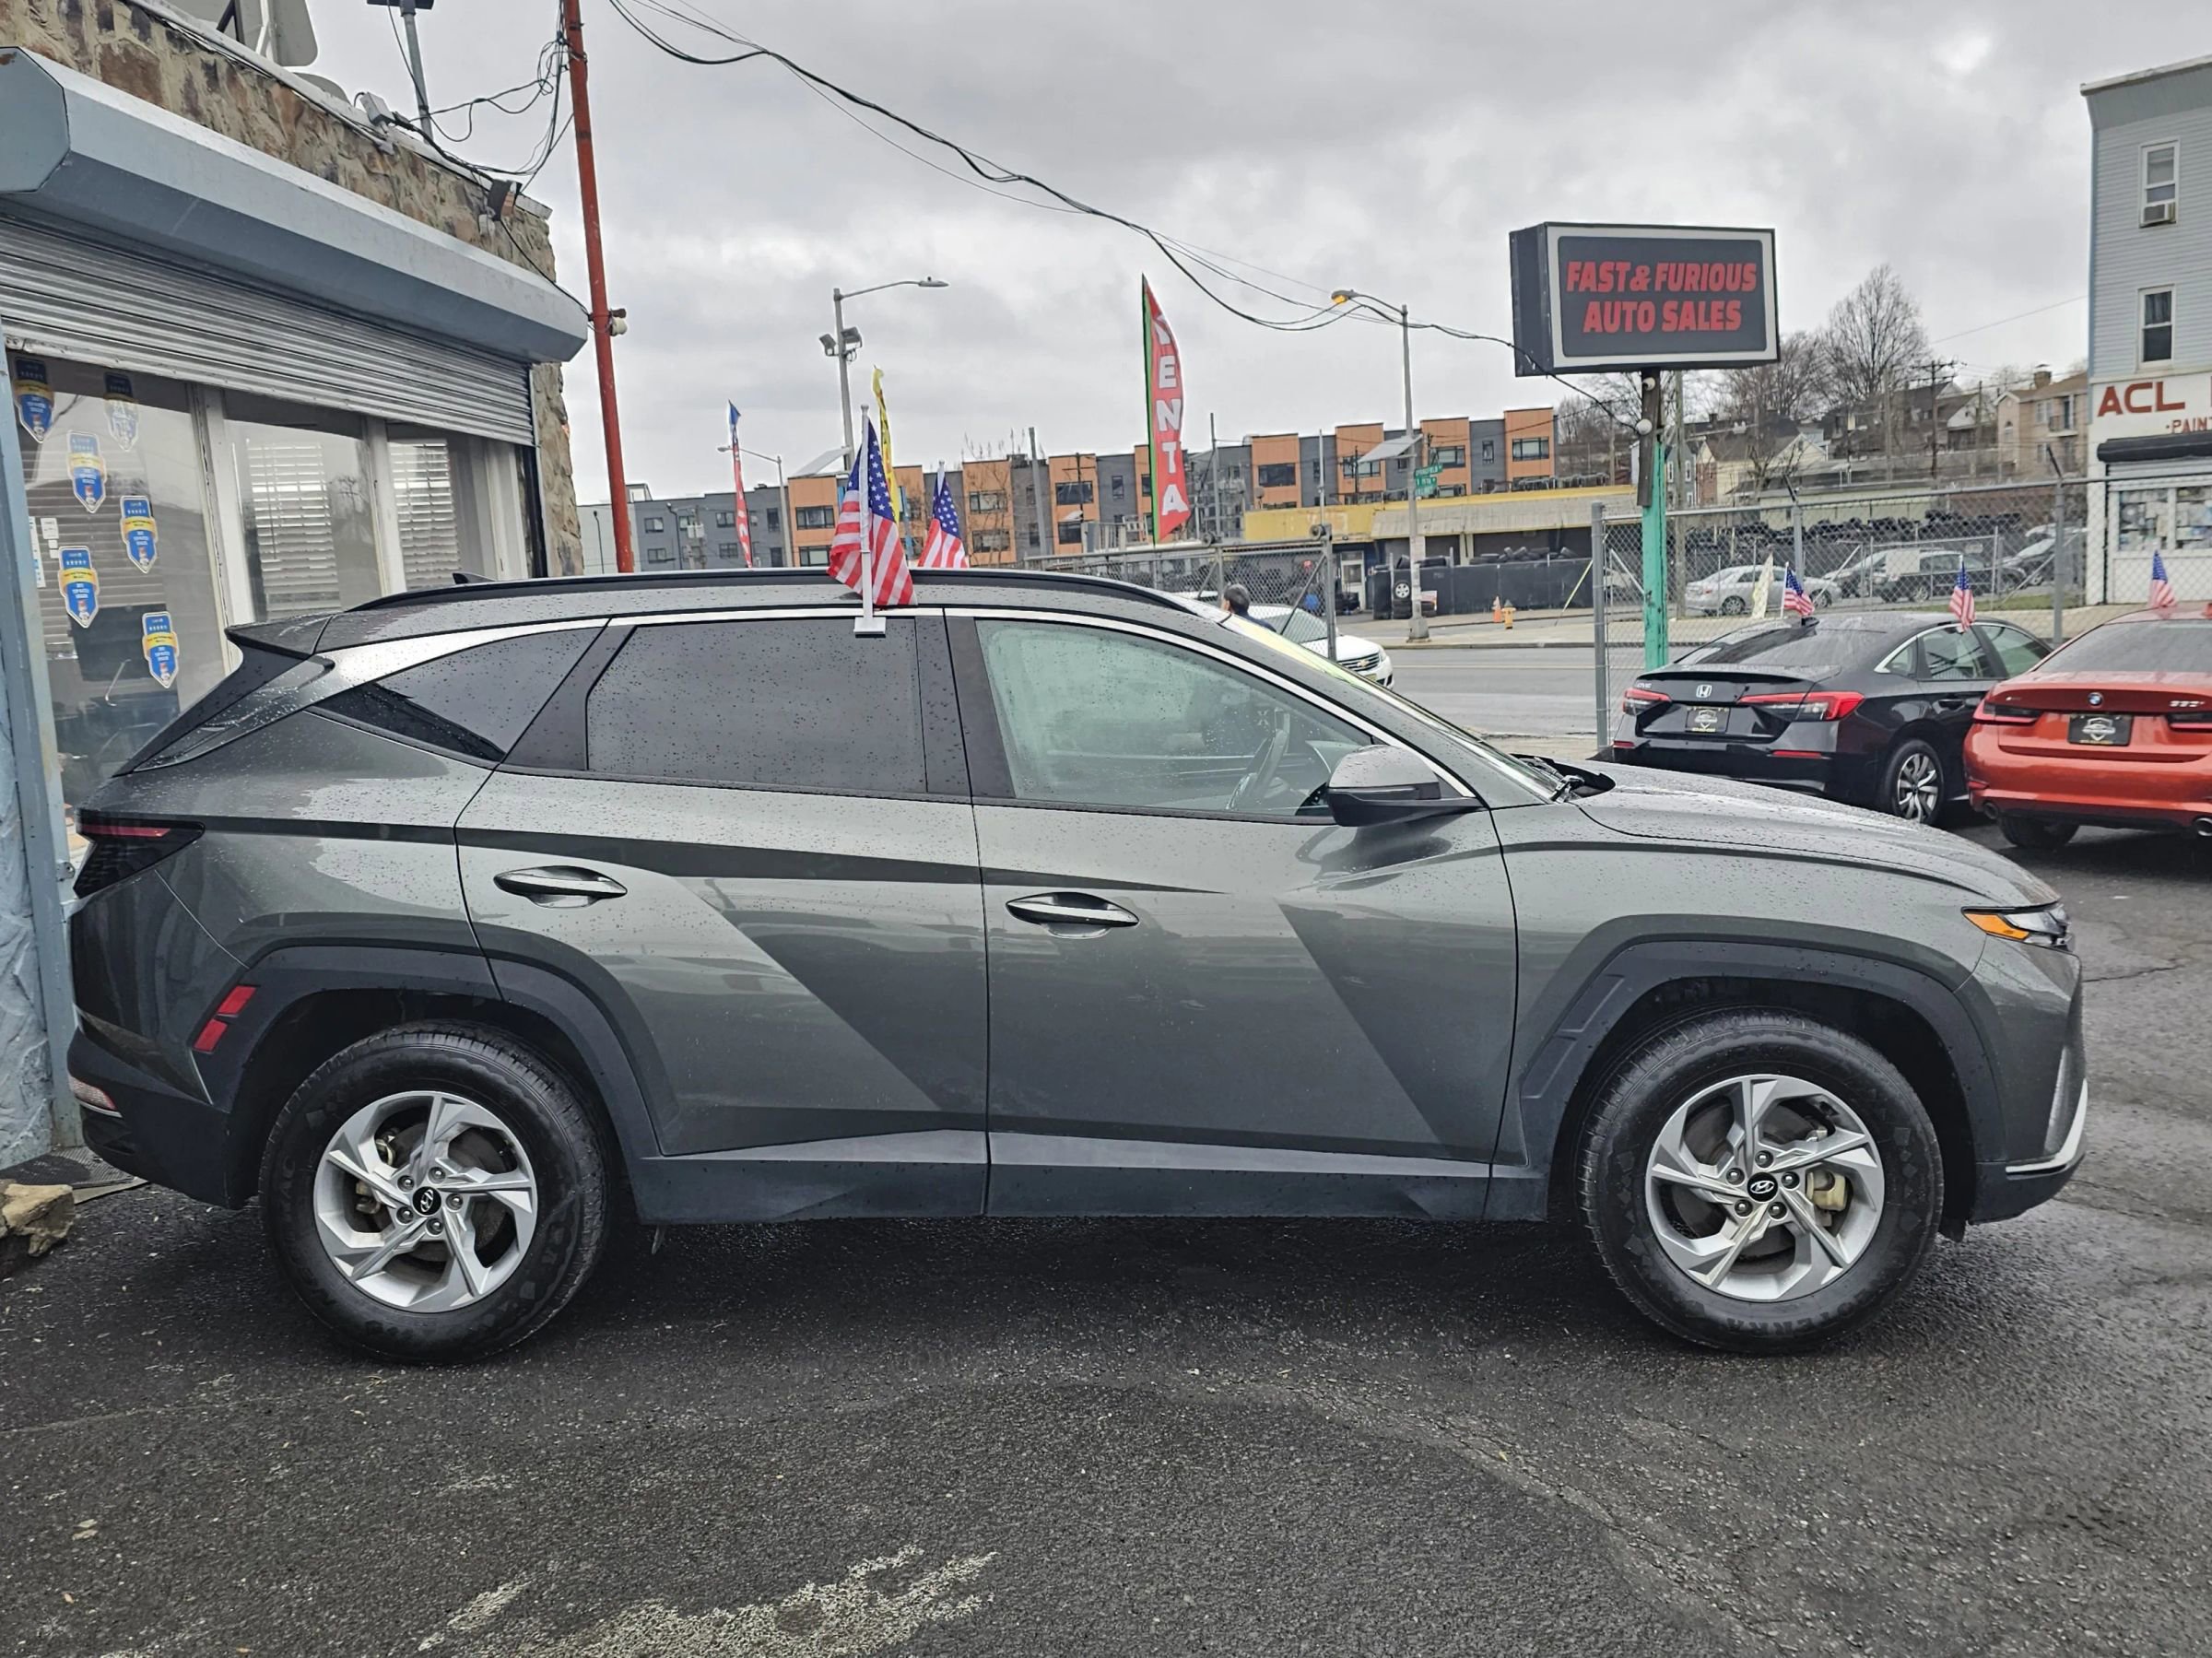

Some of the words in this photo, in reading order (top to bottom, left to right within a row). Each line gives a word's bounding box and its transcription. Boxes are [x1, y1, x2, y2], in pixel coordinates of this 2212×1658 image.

[1567, 261, 1631, 293] FAST
[1630, 265, 1651, 292] &
[1654, 263, 1757, 292] FURIOUS
[1583, 300, 1656, 334] AUTO
[1662, 300, 1742, 332] SALES
[2097, 381, 2185, 417] ACL
